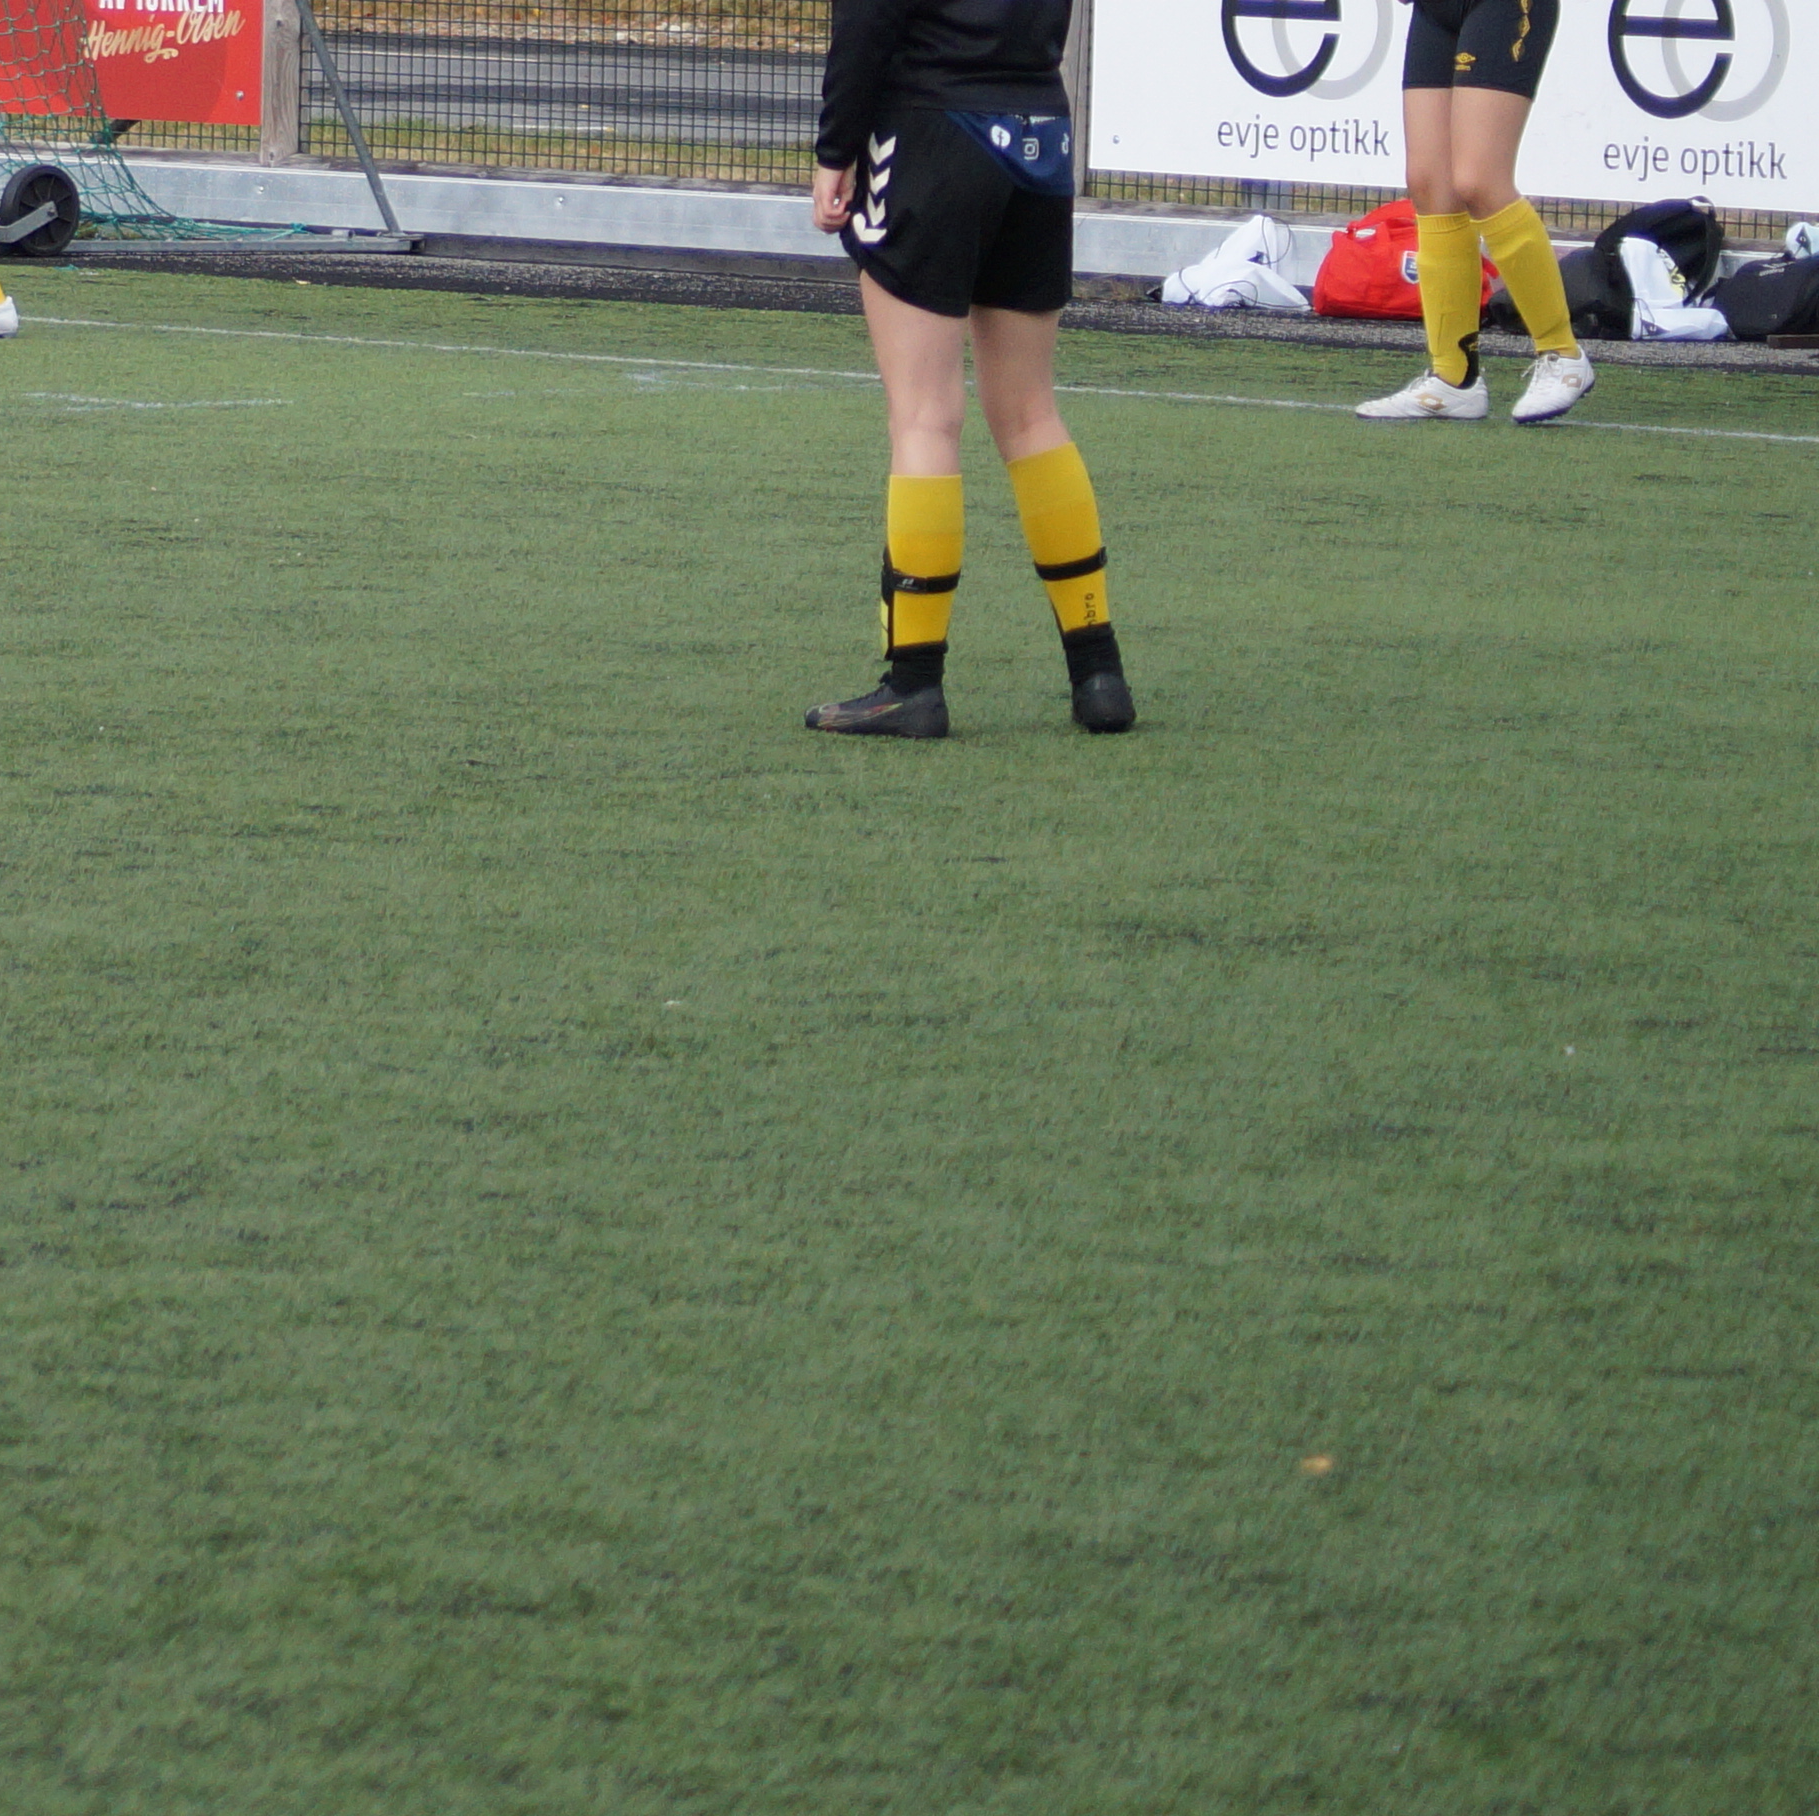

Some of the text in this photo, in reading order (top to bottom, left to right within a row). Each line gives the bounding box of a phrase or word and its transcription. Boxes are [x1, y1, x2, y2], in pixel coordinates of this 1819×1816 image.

[84, 8, 246, 64] Hennig-Olsen
[1217, 114, 1391, 162] evje optikk
[1603, 136, 1788, 185] evje optikk
